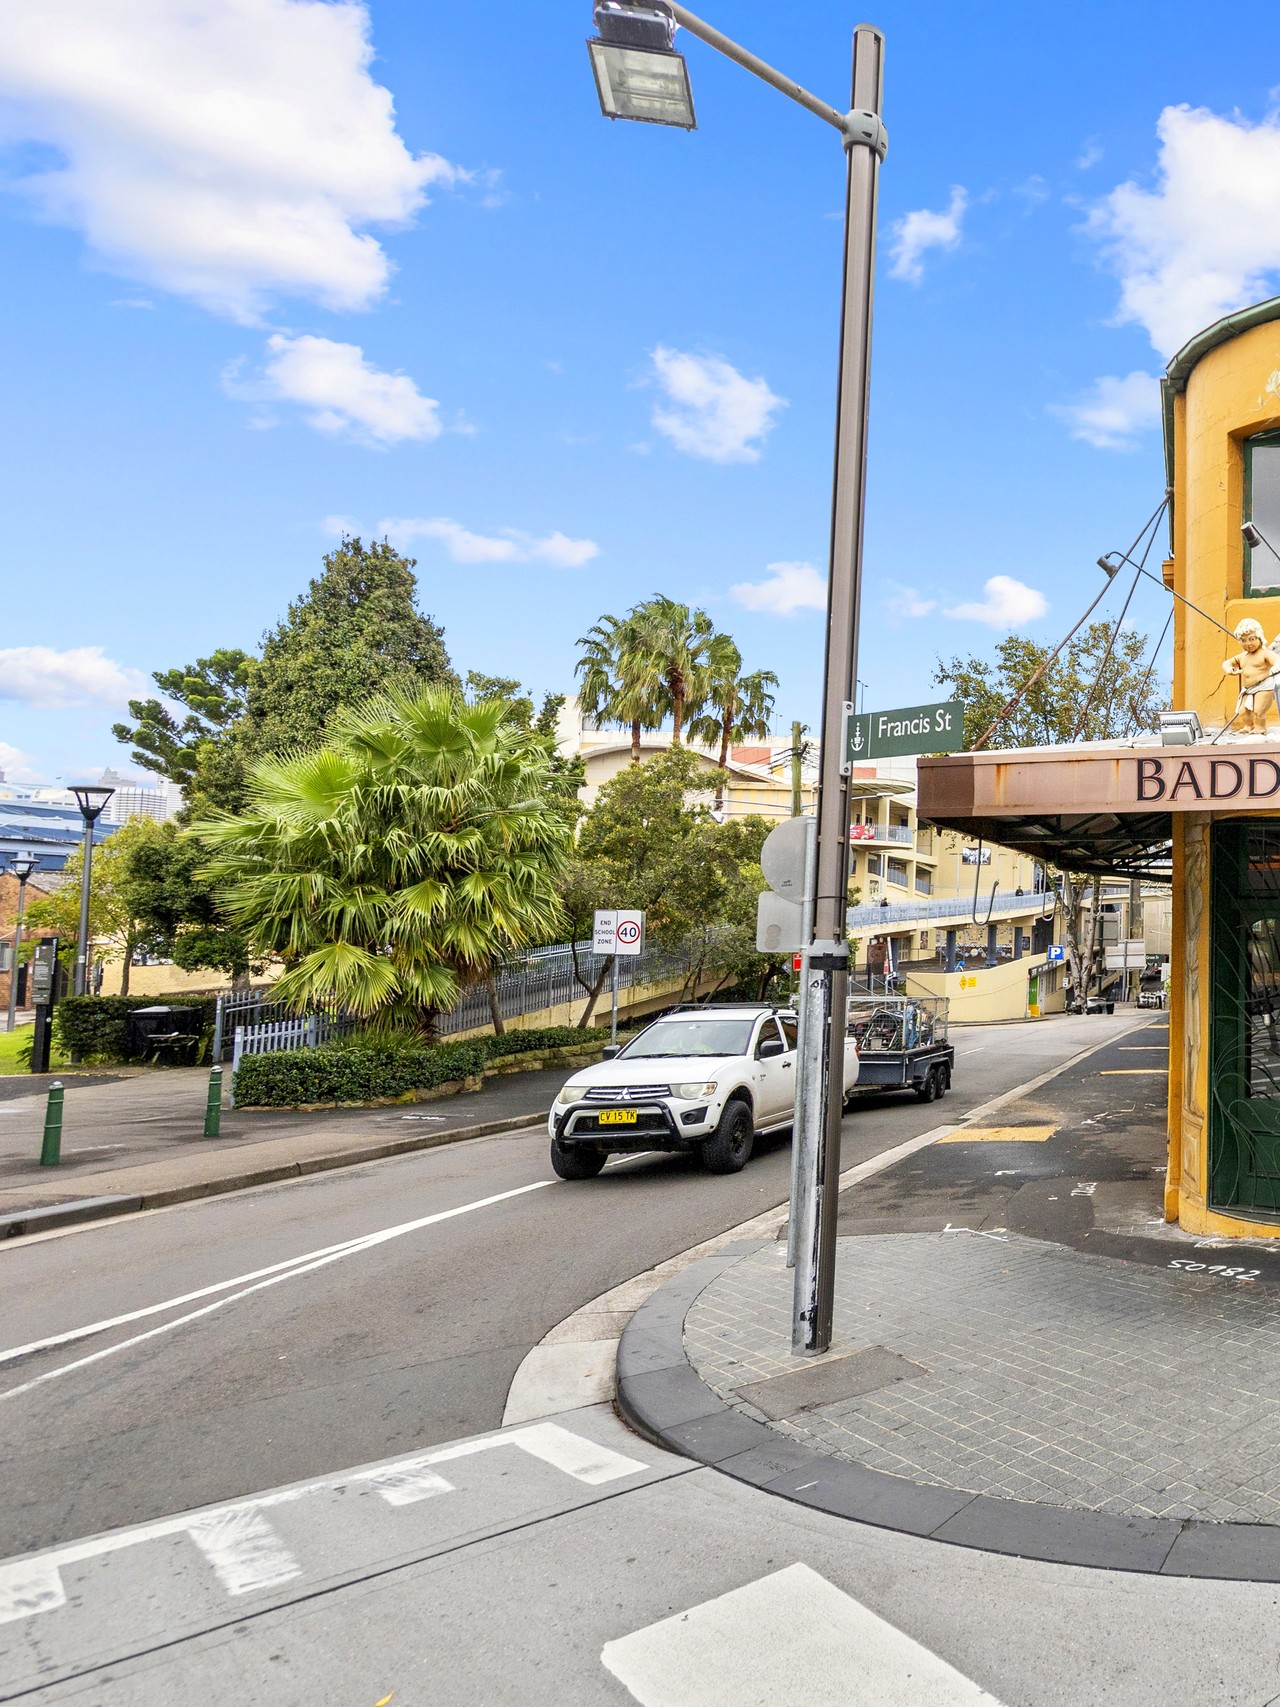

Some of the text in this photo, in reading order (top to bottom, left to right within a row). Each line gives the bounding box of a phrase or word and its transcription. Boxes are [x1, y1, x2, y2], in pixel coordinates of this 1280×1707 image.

[878, 709, 952, 738] Francis St
[620, 927, 637, 937] 40
[1050, 947, 1061, 958] P
[600, 1112, 611, 1121] CV
[614, 1112, 623, 1120] 15
